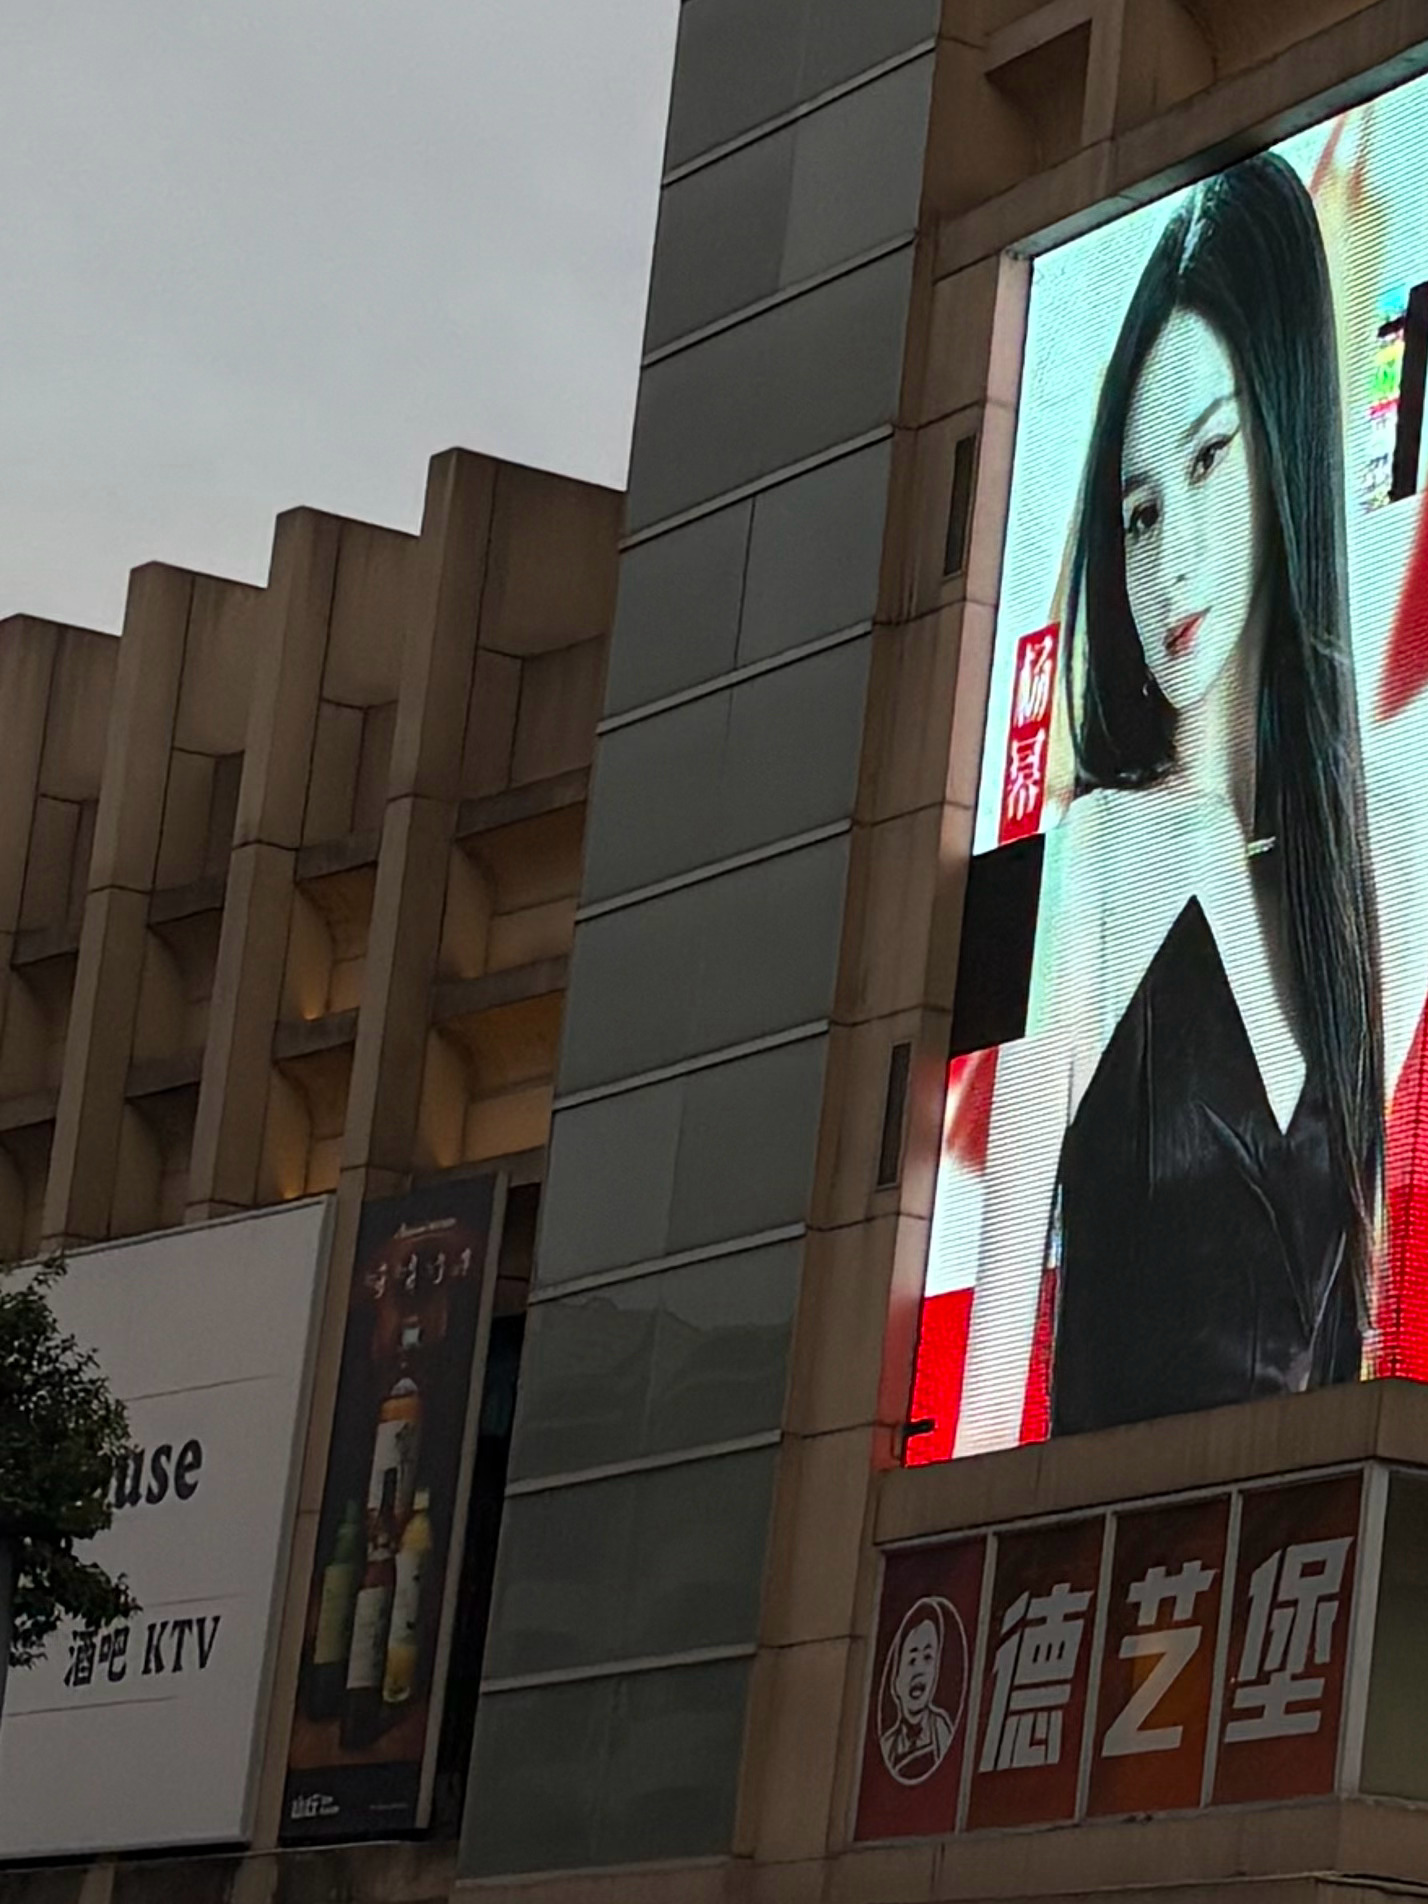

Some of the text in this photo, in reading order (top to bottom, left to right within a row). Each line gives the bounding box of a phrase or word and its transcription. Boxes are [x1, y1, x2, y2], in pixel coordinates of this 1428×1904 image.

[64, 1615, 222, 1688] 酒吧 KTV
[978, 1536, 1355, 1773] 德艺堡
